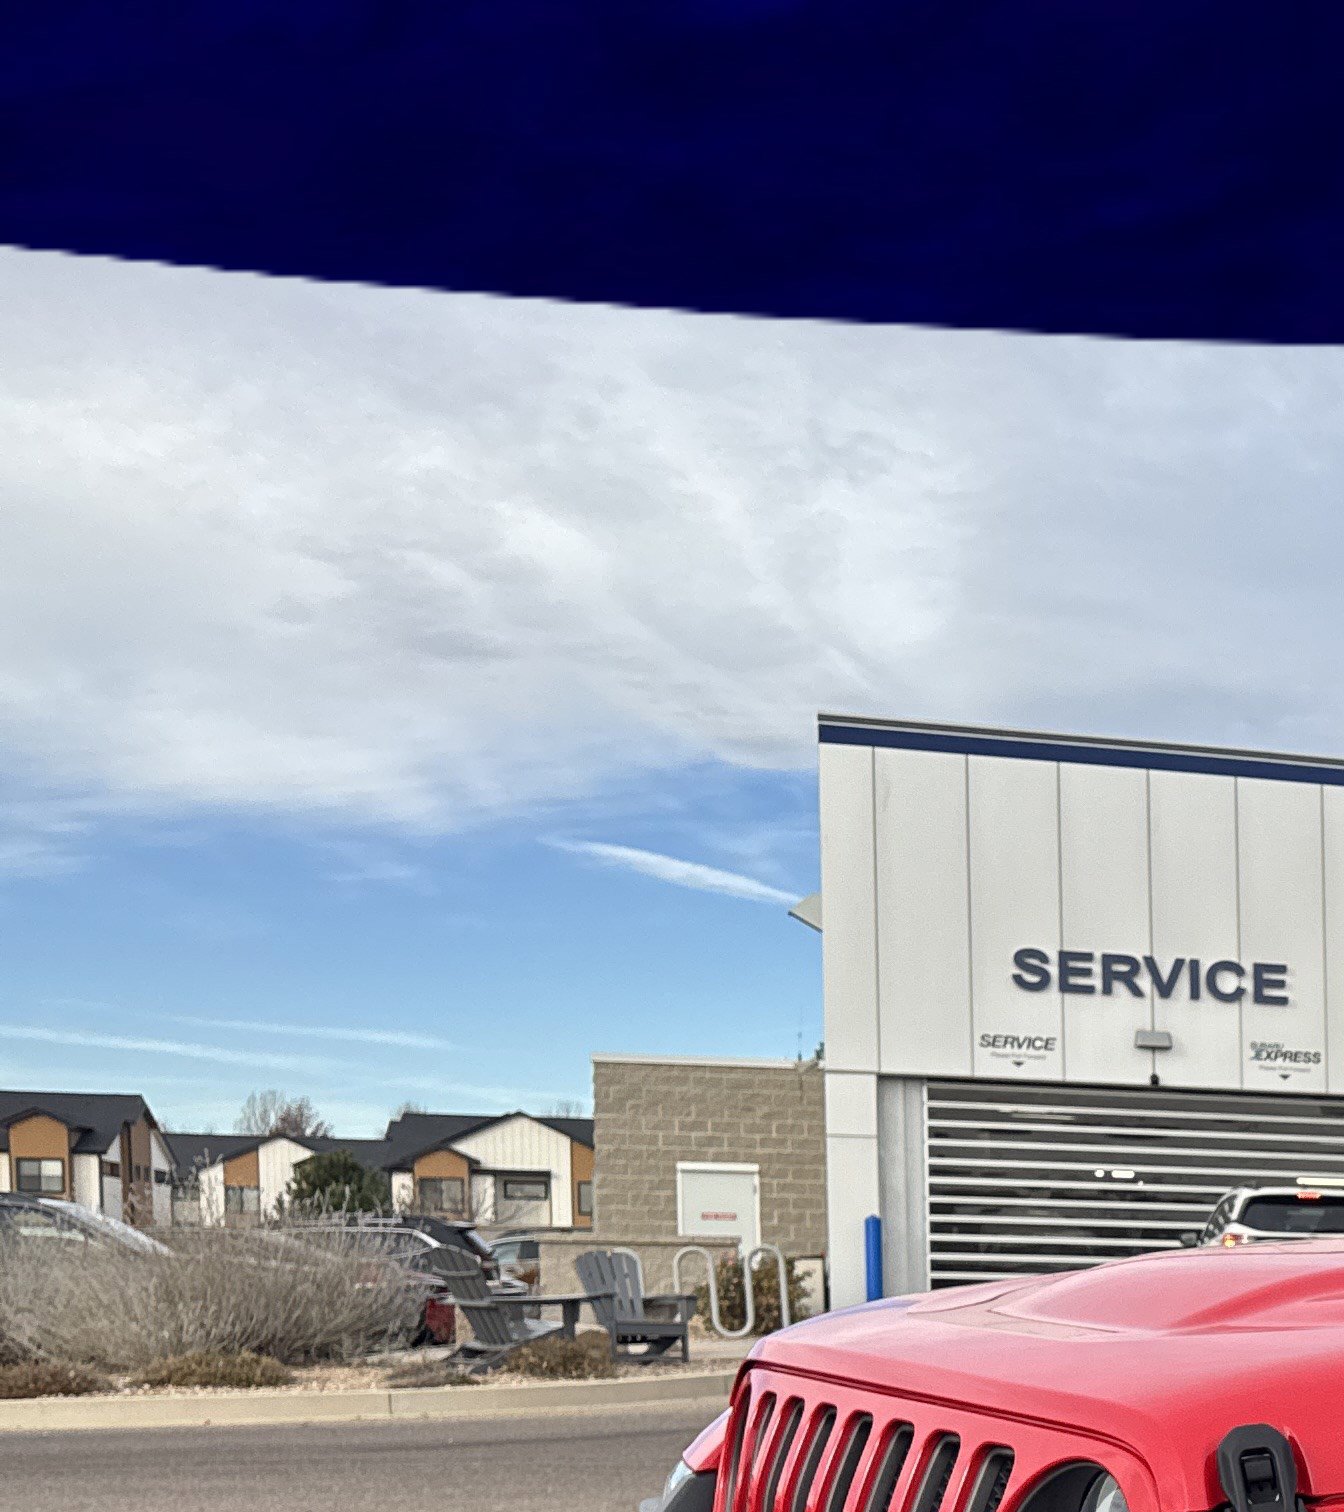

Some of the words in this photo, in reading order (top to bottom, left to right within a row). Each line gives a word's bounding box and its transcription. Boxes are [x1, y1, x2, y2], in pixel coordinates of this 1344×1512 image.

[1011, 947, 1290, 1005] SERVICE
[979, 1033, 1057, 1051] SERVICE
[1250, 1049, 1321, 1064] EXPRESS
